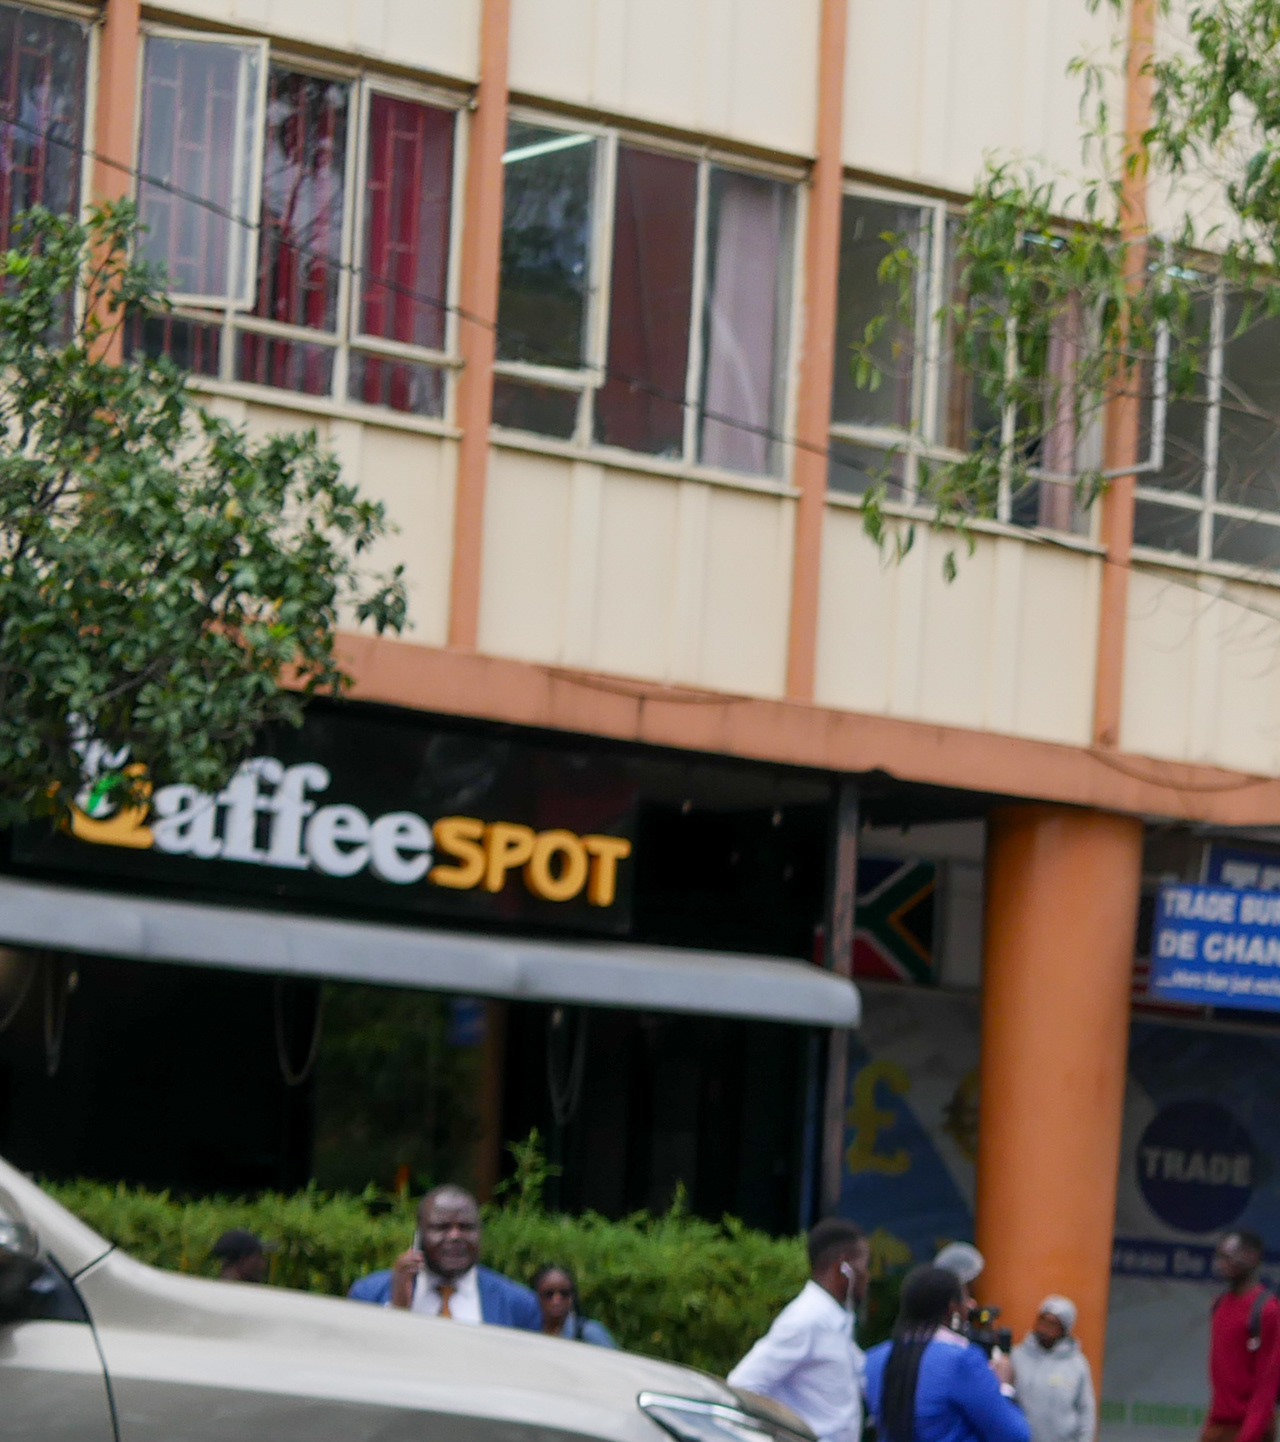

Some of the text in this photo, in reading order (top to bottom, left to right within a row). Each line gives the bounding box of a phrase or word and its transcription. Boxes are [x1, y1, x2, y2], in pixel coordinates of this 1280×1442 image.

[1161, 888, 1237, 925] TRADE
[1157, 928, 1198, 960] DE
[1144, 1146, 1250, 1187] TRADE
